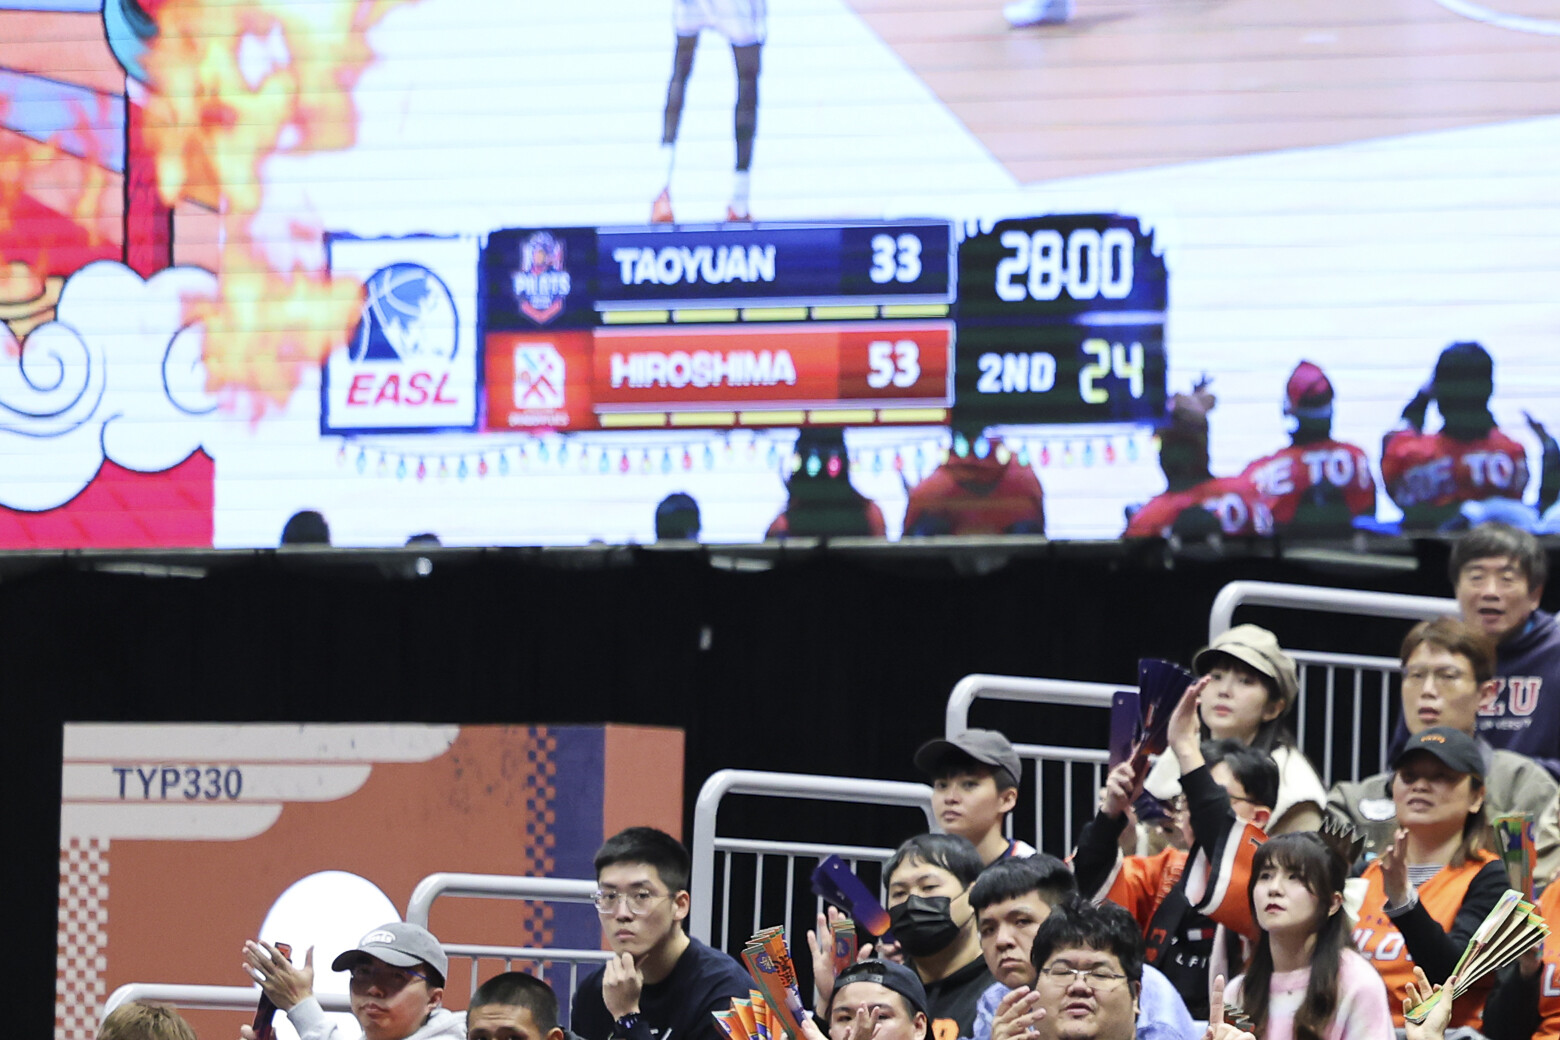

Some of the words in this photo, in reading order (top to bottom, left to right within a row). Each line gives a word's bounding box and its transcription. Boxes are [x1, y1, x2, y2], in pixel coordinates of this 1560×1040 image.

[612, 244, 777, 285] TAOYUAN
[868, 233, 923, 284] 33
[610, 349, 797, 389] HIROSHIMA
[866, 340, 921, 389] 53
[976, 352, 1057, 393] 2ND
[1078, 337, 1145, 404] 24
[346, 372, 459, 407] EASL
[112, 766, 243, 801] TYP330
